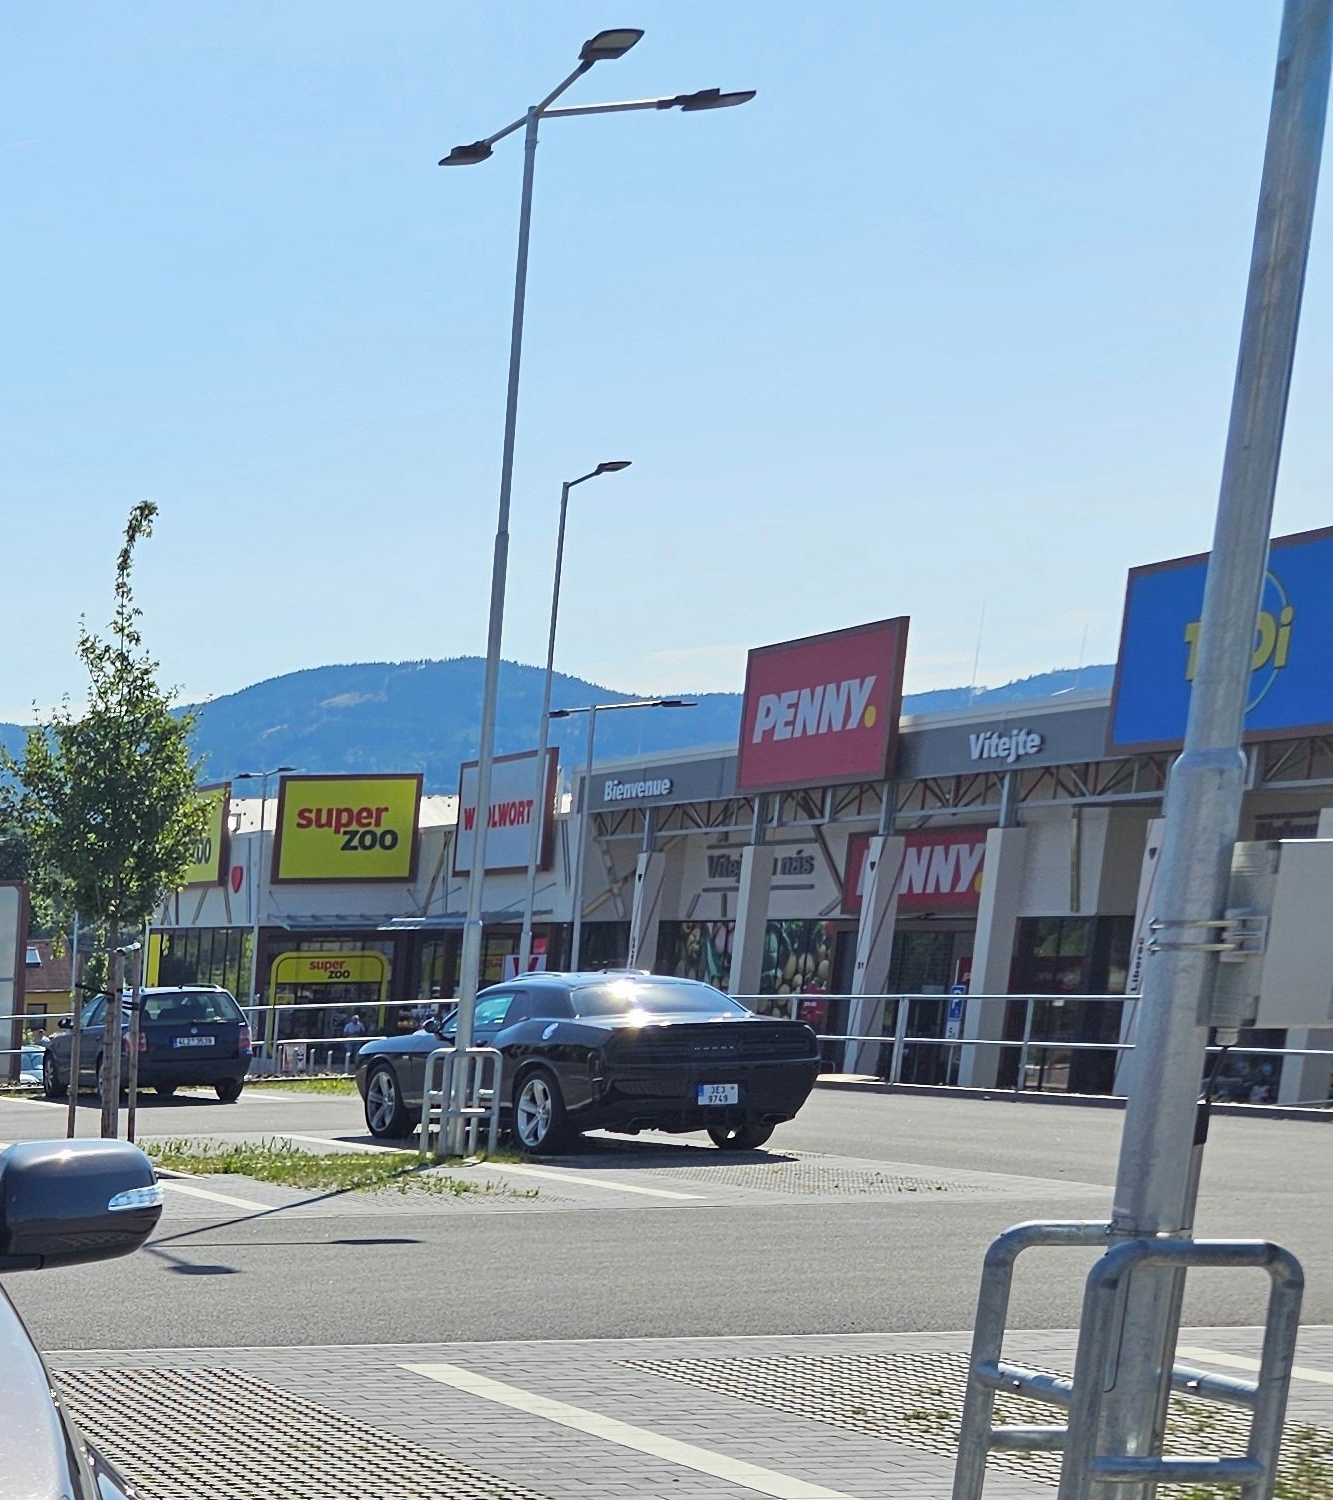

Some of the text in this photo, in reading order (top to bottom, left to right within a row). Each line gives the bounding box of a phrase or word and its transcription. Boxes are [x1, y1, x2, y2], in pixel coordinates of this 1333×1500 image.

[969, 727, 1042, 763] Vítejte
[604, 777, 673, 801] Bienvenue
[296, 806, 389, 834] super
[309, 960, 347, 971] super
